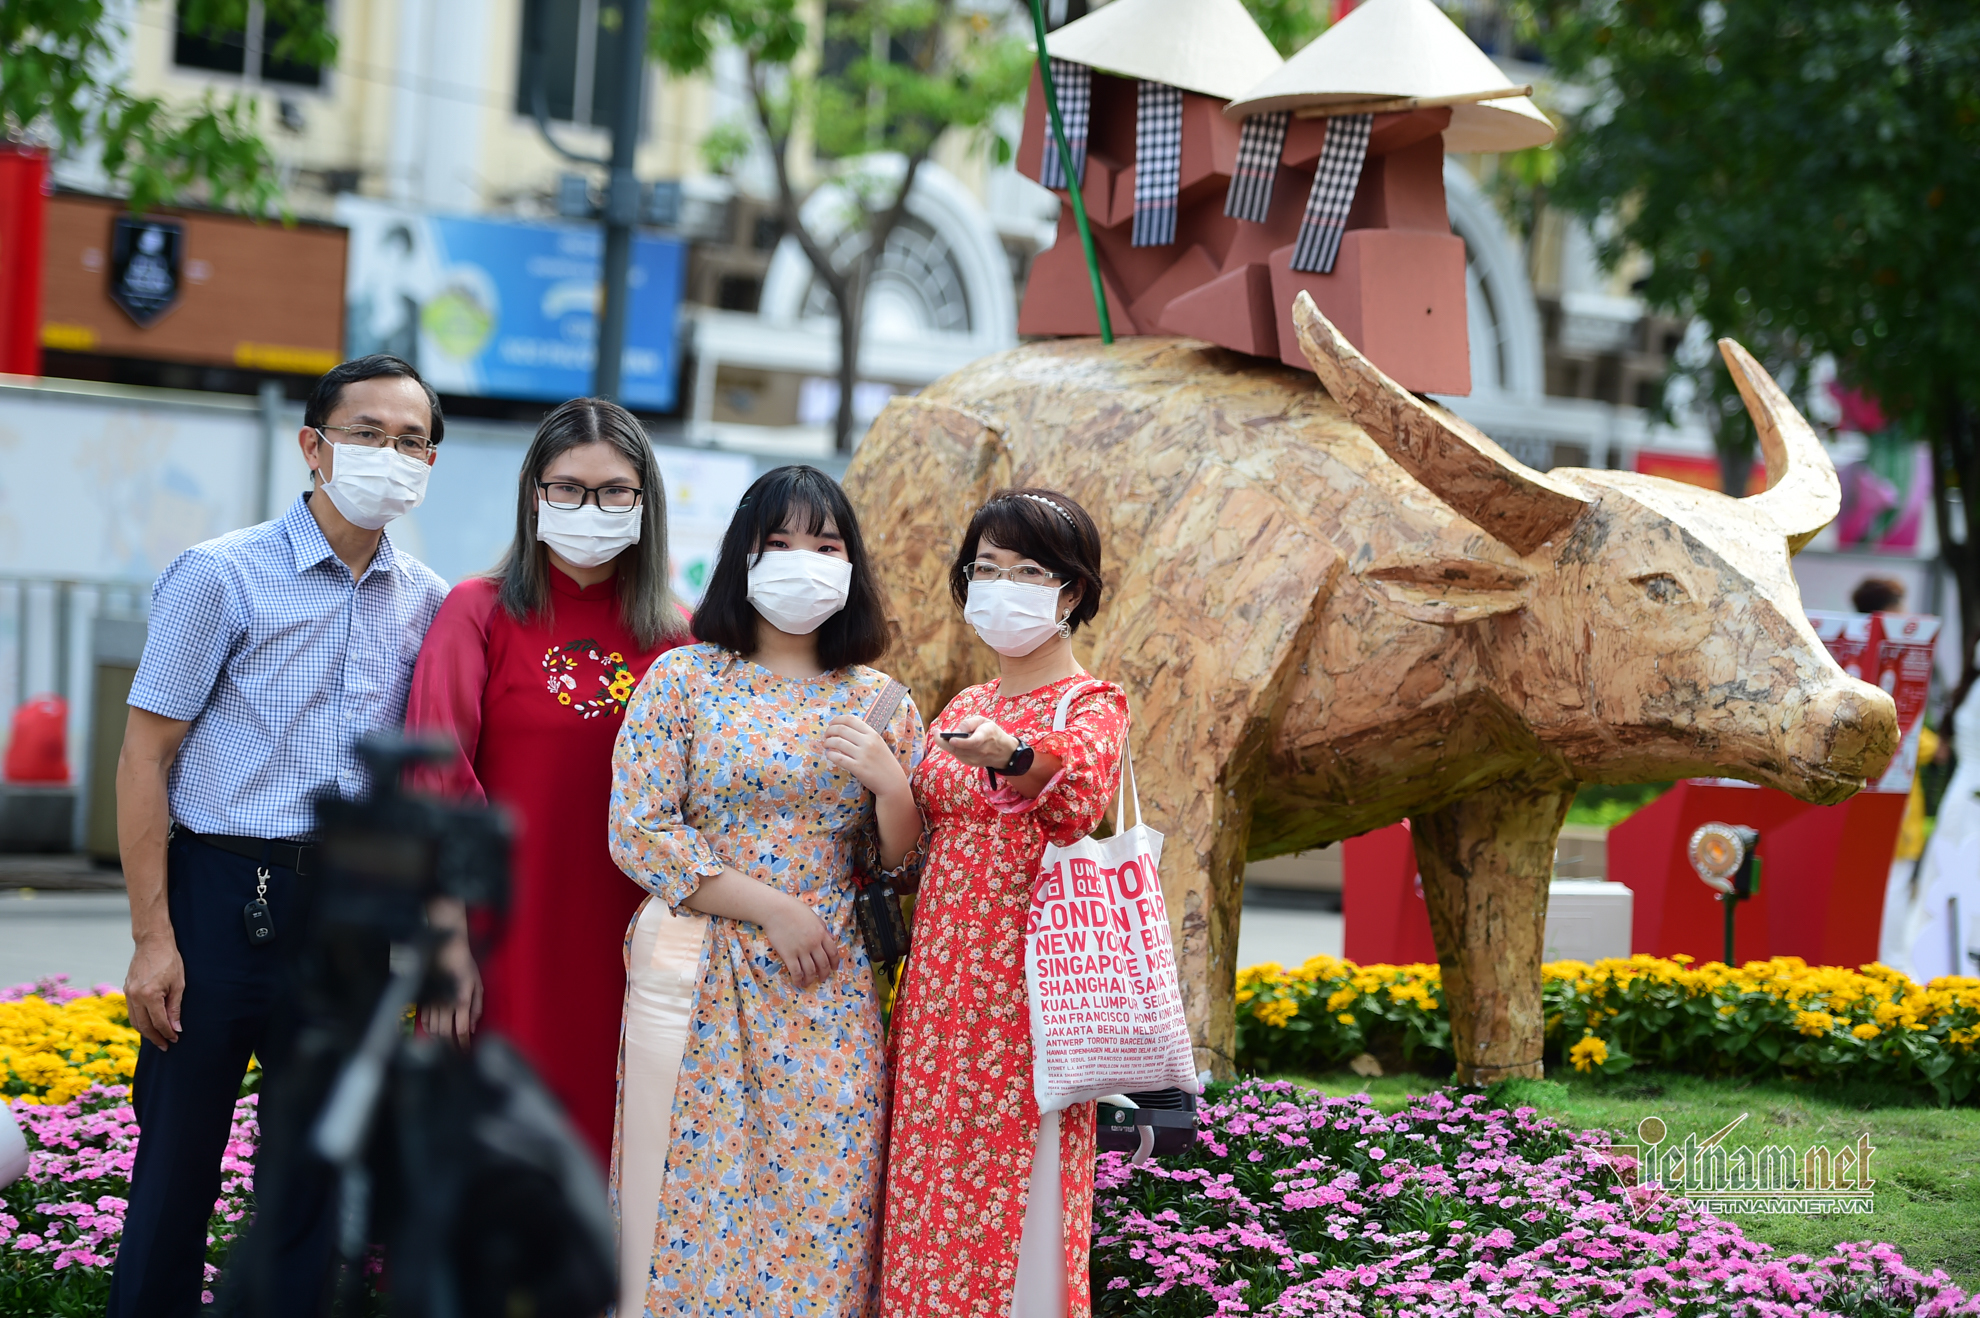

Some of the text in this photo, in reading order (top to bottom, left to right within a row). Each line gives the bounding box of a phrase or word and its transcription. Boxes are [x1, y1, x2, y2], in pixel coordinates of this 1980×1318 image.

[1074, 863, 1100, 878] UNI
[1077, 879, 1103, 895] QLO
[1039, 900, 1131, 933] ONDN
[1036, 931, 1086, 956] NEW
[1093, 930, 1136, 957] YOK
[1036, 955, 1141, 978] SINGAPOE
[1039, 977, 1126, 997] SHANGHAI
[1041, 996, 1090, 1012] KUALA
[1093, 996, 1139, 1010] LUMPUR
[1043, 1014, 1067, 1025] SAN
[1069, 1011, 1130, 1024] FRANCISCO
[1134, 1011, 1158, 1023] HONG
[1045, 1025, 1093, 1037] JAKARTA
[1098, 1025, 1130, 1035] BERLIN
[1133, 1021, 1172, 1036] MELBOURNE
[1046, 1038, 1084, 1047] ANTWERP
[1087, 1036, 1118, 1045] TORONTO
[1120, 1037, 1156, 1045] BARCELONA
[1069, 1047, 1103, 1055] COPENHAGEN
